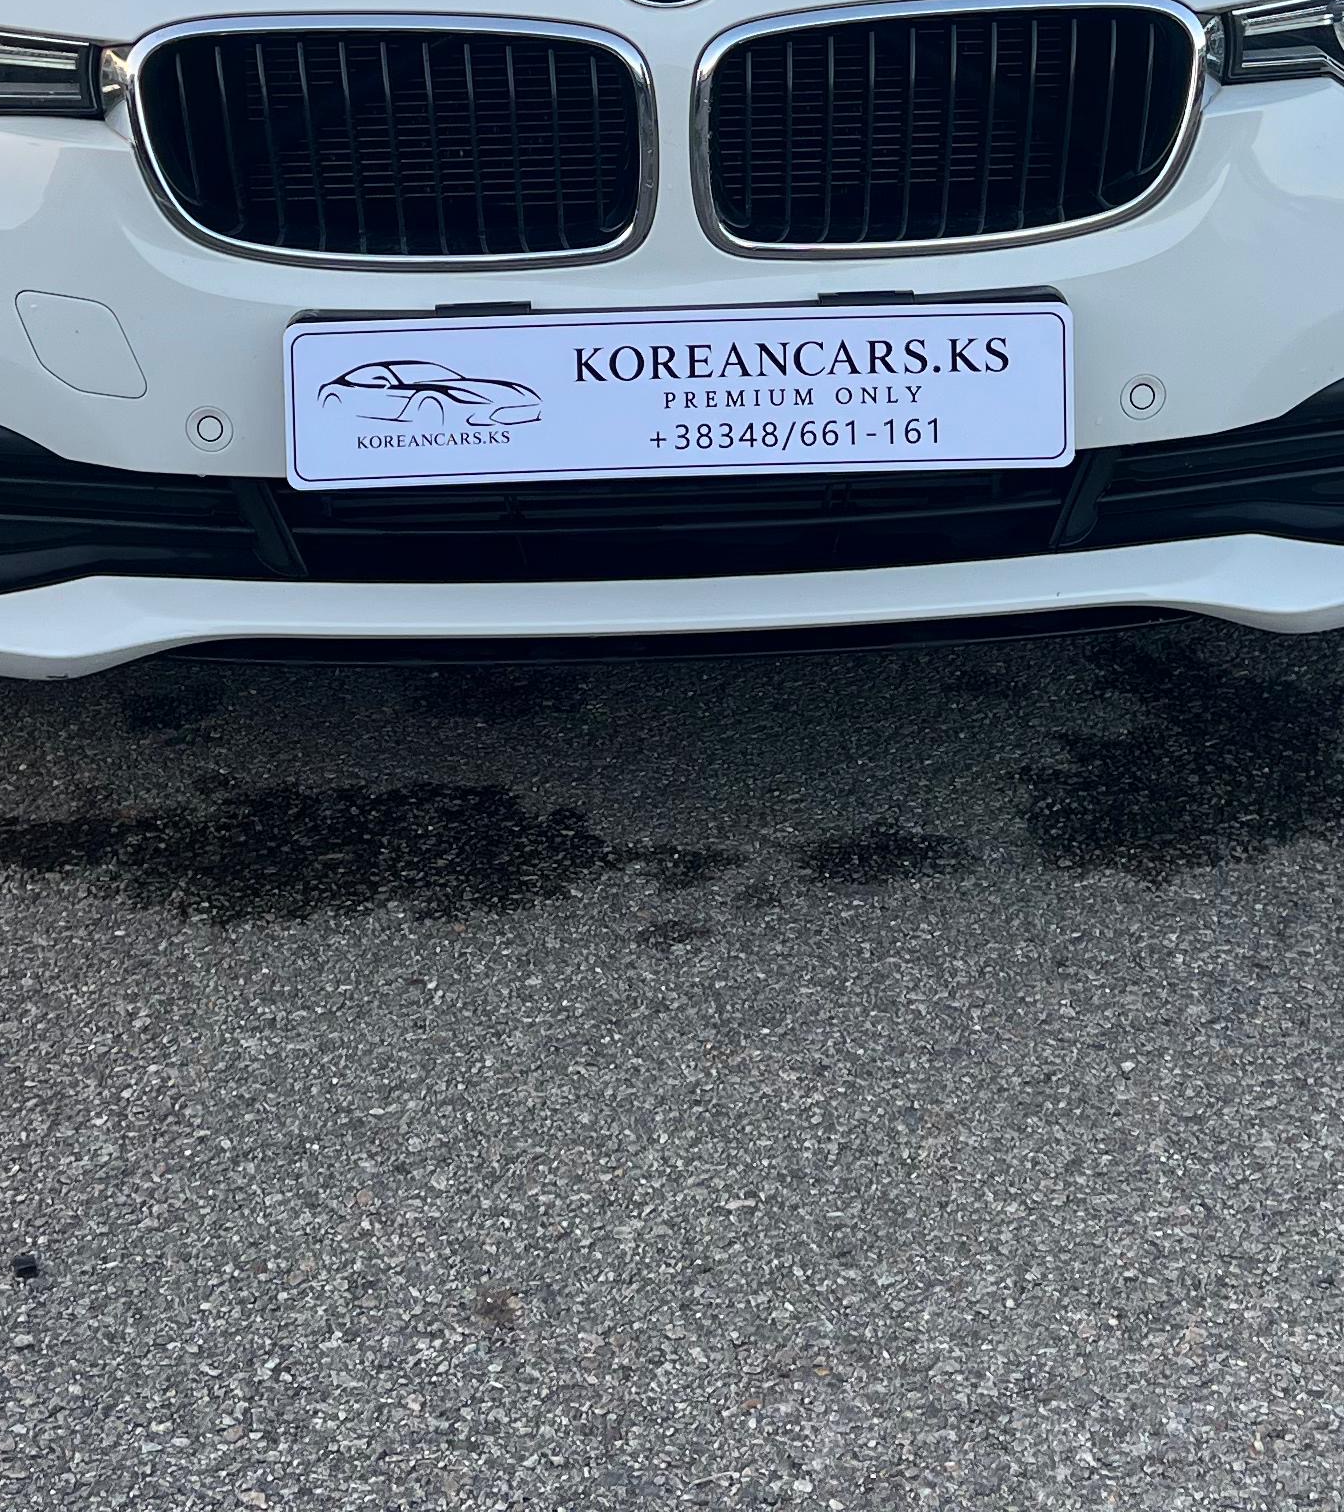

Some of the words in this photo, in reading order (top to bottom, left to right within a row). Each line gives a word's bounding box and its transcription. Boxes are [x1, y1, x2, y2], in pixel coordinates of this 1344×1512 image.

[574, 337, 1010, 383] KOREANCARS.KS
[663, 388, 816, 410] PREMIUM
[835, 385, 924, 405] ONLY
[356, 430, 511, 450] KOREANCARS.KS
[649, 417, 942, 452] +38348/661-161
